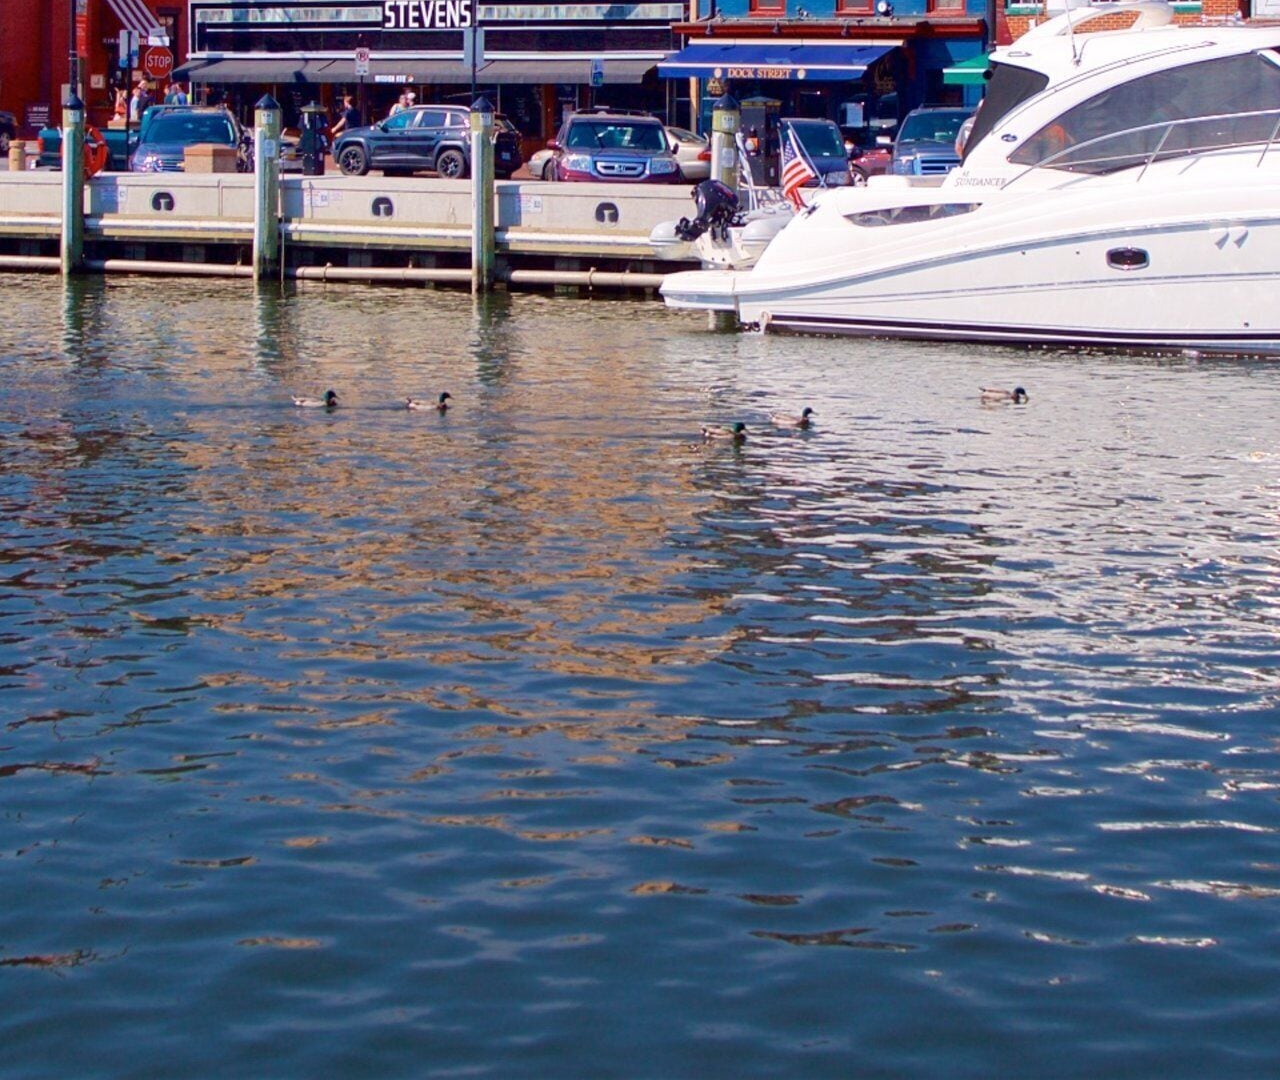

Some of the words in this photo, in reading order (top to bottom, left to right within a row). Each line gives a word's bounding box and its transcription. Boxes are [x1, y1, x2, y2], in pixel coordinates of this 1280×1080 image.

[384, 0, 472, 28] STEVENS
[147, 55, 171, 68] STOP
[727, 68, 755, 78] DOCK
[756, 68, 792, 79] STREET
